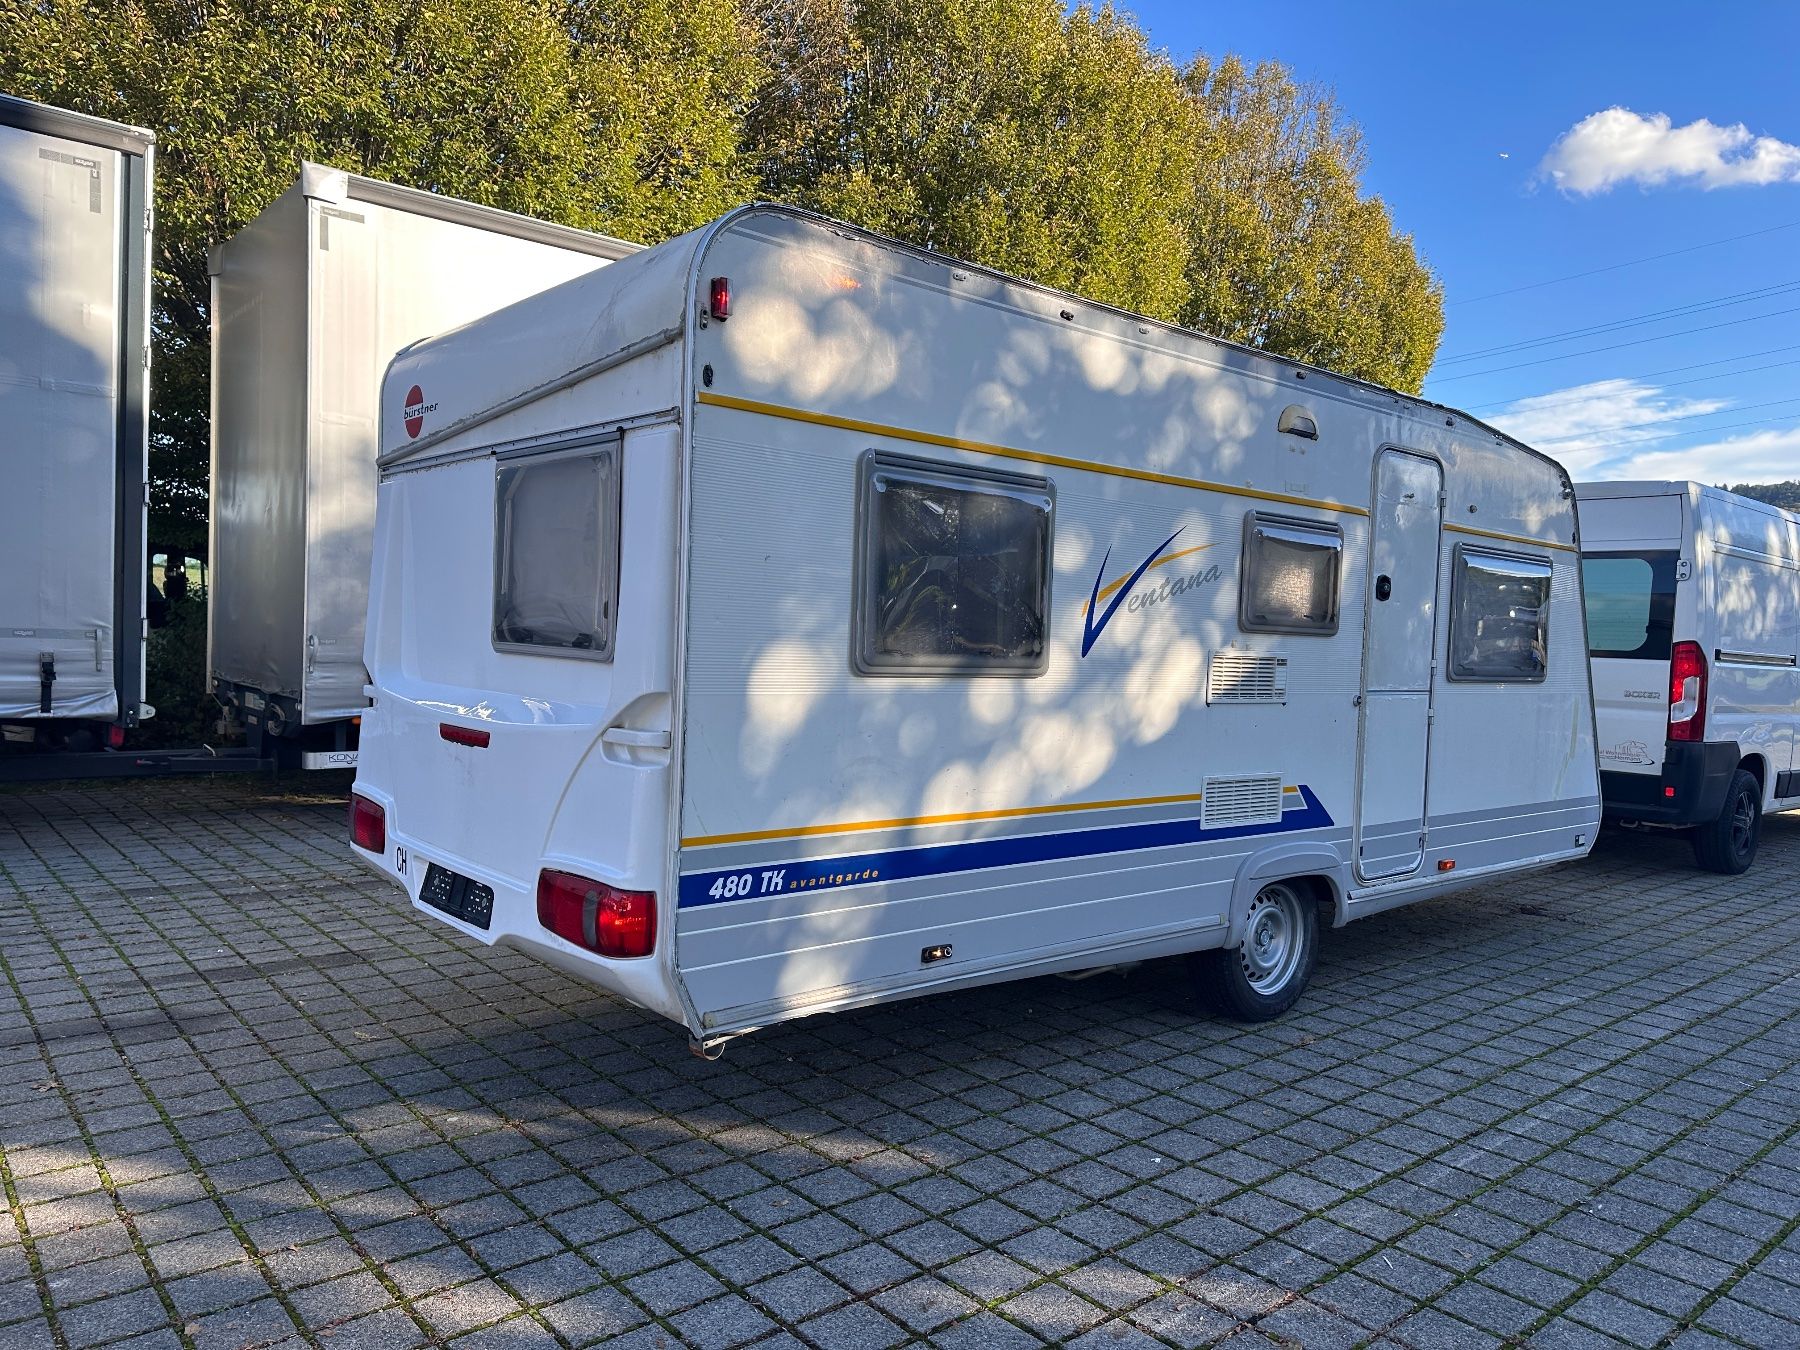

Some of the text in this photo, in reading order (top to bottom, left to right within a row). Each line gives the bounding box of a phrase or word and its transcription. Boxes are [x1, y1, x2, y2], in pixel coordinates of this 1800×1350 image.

[404, 403, 438, 420] bürstner
[1081, 524, 1223, 659] Ventana
[1624, 690, 1660, 699] BOXER
[396, 846, 407, 875] CH
[709, 869, 879, 899] 480 TK avantgarde
